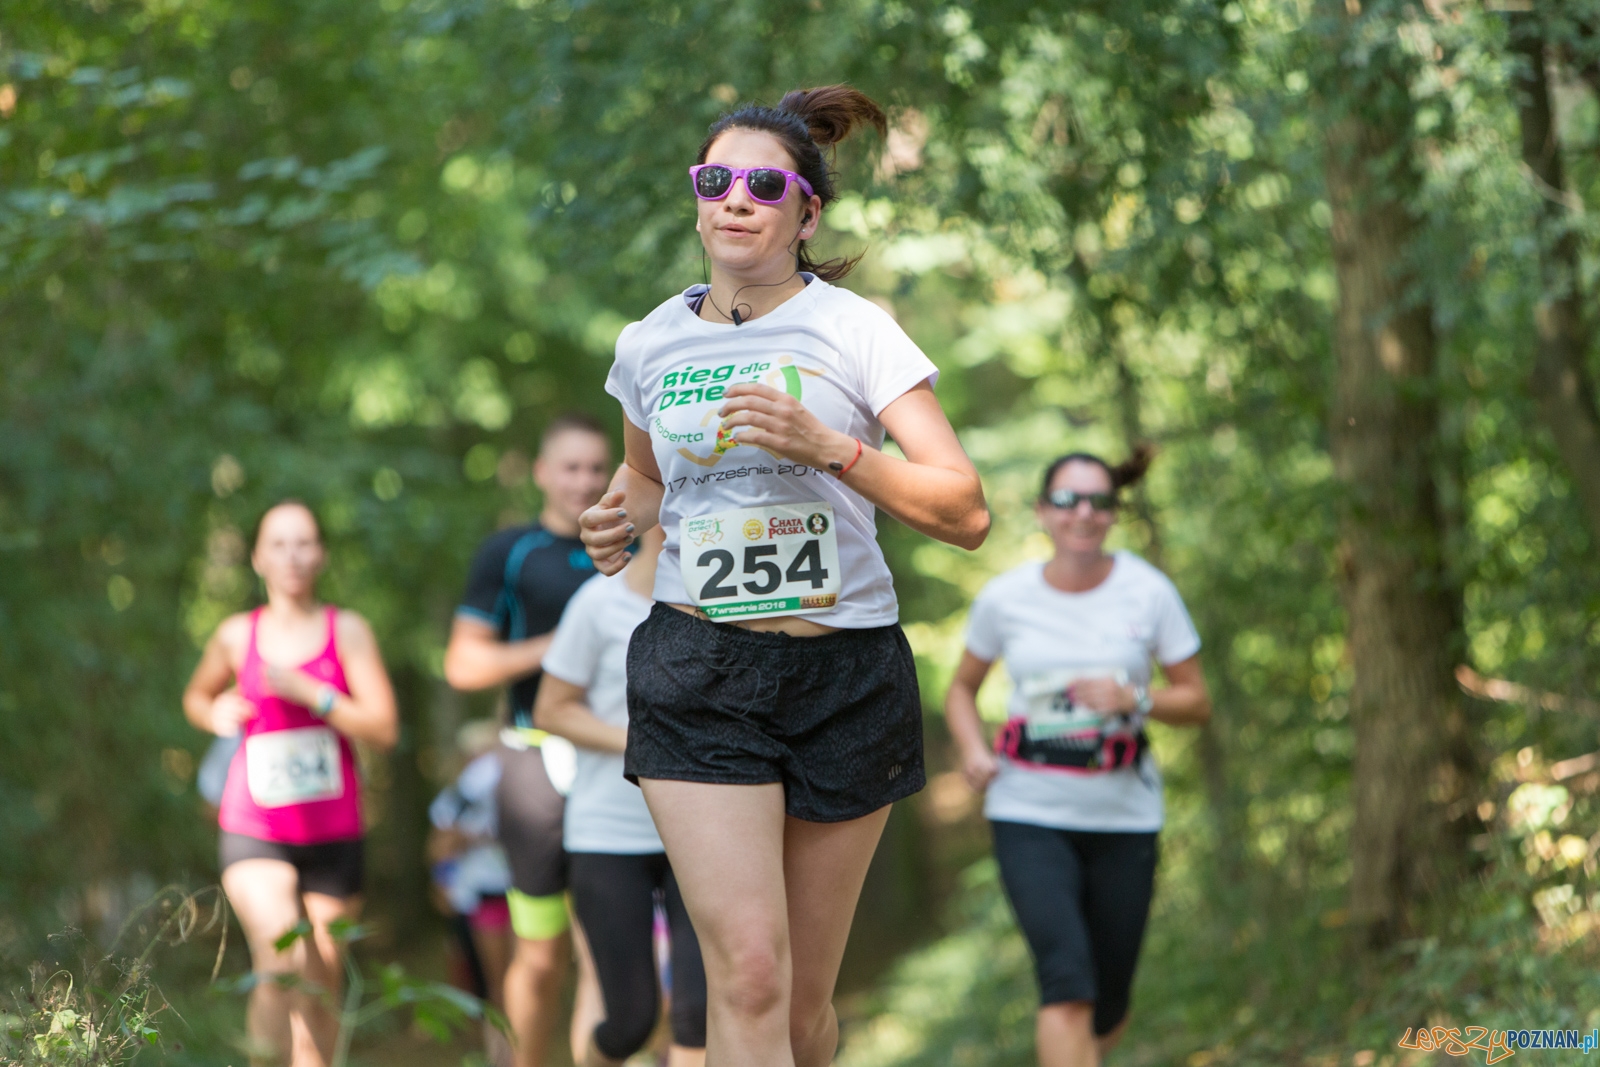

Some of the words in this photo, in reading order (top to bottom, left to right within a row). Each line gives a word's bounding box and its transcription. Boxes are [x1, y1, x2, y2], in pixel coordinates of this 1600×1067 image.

[662, 364, 736, 389] Bieg
[740, 362, 771, 375] dla
[654, 417, 704, 443] Roberta
[667, 477, 687, 493] 17
[692, 464, 773, 486] września
[768, 526, 806, 540] POLSKA
[769, 517, 804, 528] CHATA
[696, 539, 829, 600] 254
[706, 607, 717, 616] 17
[758, 601, 787, 611] 2016
